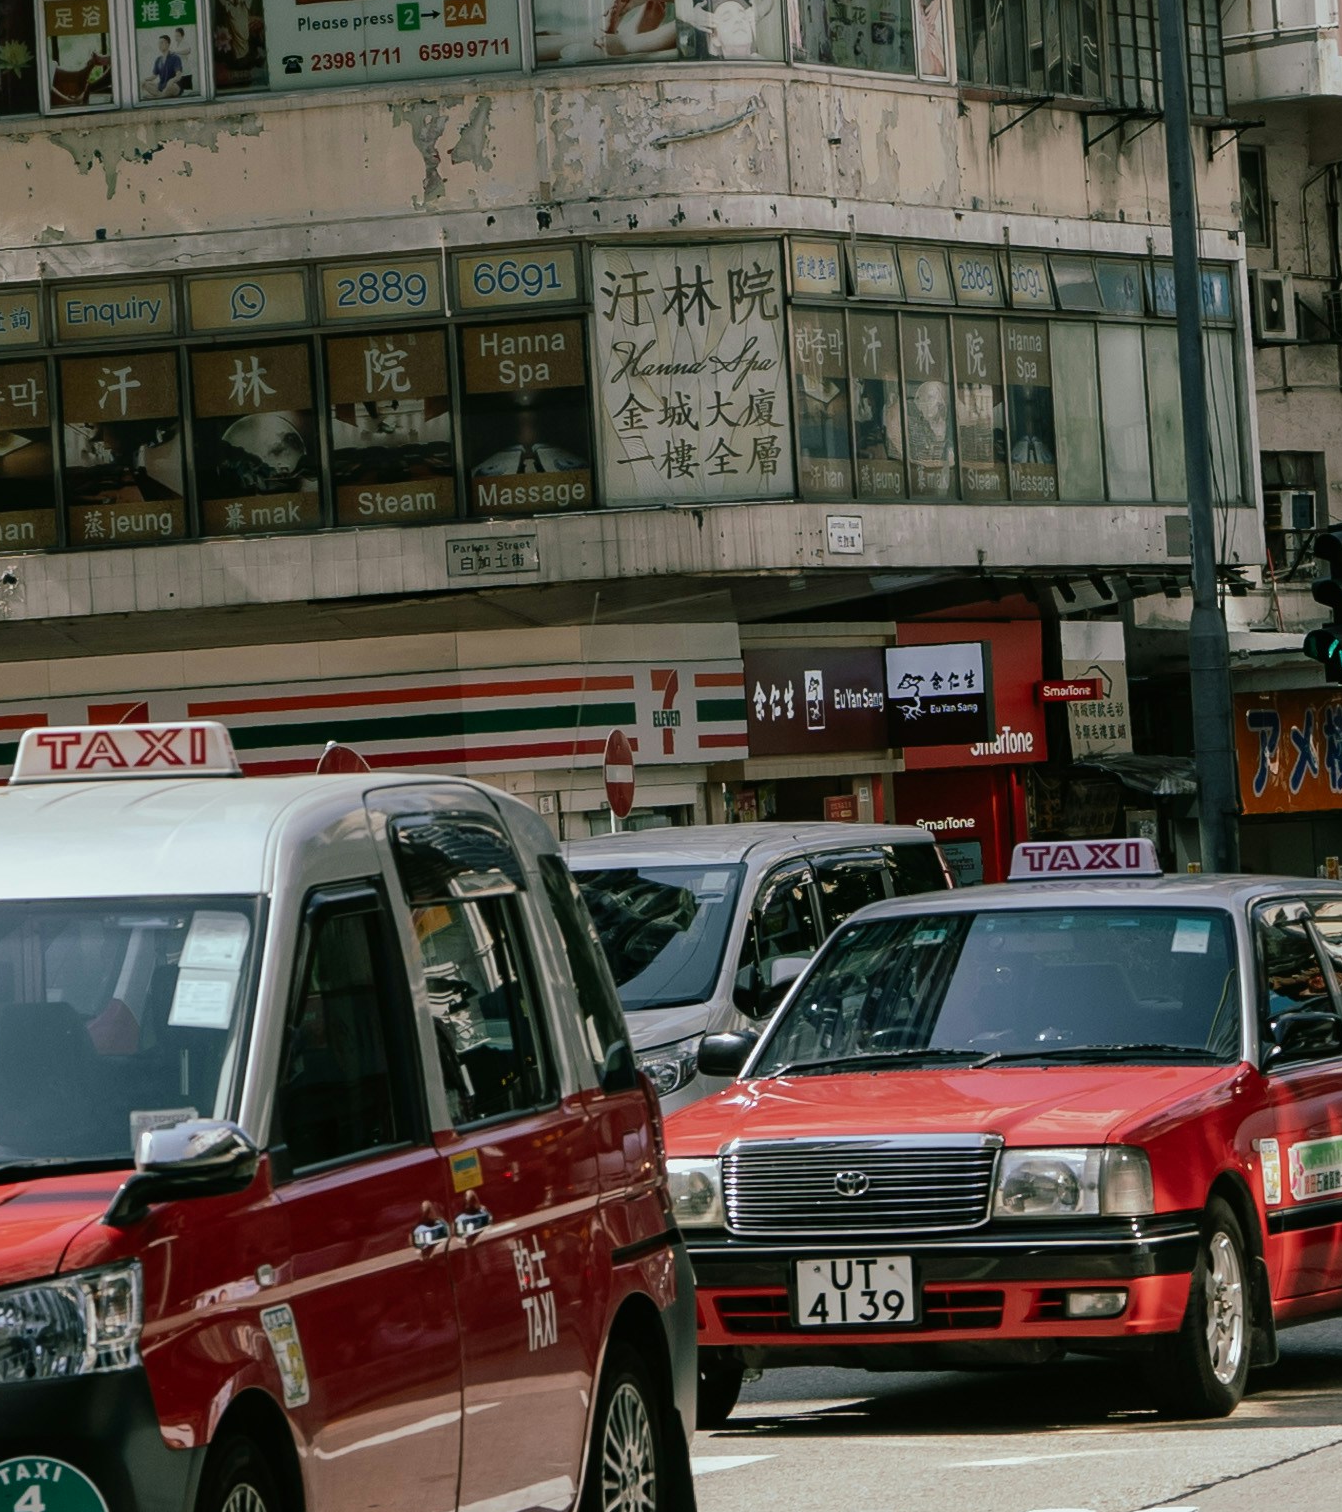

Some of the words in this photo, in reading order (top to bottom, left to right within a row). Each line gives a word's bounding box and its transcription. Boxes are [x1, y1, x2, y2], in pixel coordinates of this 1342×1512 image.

[54, 5, 101, 29] 足浴
[297, 16, 349, 32] Please
[353, 12, 394, 31] press
[403, 9, 415, 26] 2
[446, 2, 484, 21] 24A
[958, 260, 994, 296] 2889
[65, 295, 162, 327] Enquiry
[337, 270, 427, 308] 2889
[473, 261, 562, 297] 6691
[600, 261, 780, 327] 汗林院
[479, 332, 565, 358] Hanna
[1007, 328, 1043, 353] Hanna
[499, 359, 551, 388] Spa
[611, 339, 709, 384] Hanna
[709, 336, 777, 392] Spa
[1015, 355, 1038, 379] Spa
[97, 366, 141, 416] 汗
[228, 355, 277, 408] 林
[363, 346, 412, 394] 院
[612, 388, 785, 432] 金城大廈
[616, 434, 781, 479] 一樓全層
[357, 490, 437, 516] Steam
[477, 481, 586, 507] Massage
[108, 509, 173, 539] jeung
[250, 501, 301, 527] mak
[496, 539, 532, 552] Street
[459, 554, 525, 571] 白加士街
[929, 669, 976, 691] 余仁生
[1042, 685, 1092, 698] SmarTone
[652, 709, 682, 728] ELEVEN
[36, 727, 206, 770] TAXI
[916, 815, 976, 831] SmarTone
[1022, 842, 1140, 872] TAXI
[512, 1233, 551, 1293] 的士
[830, 1258, 878, 1291] UT
[521, 1290, 558, 1352] TAXI
[807, 1289, 905, 1323] 4139
